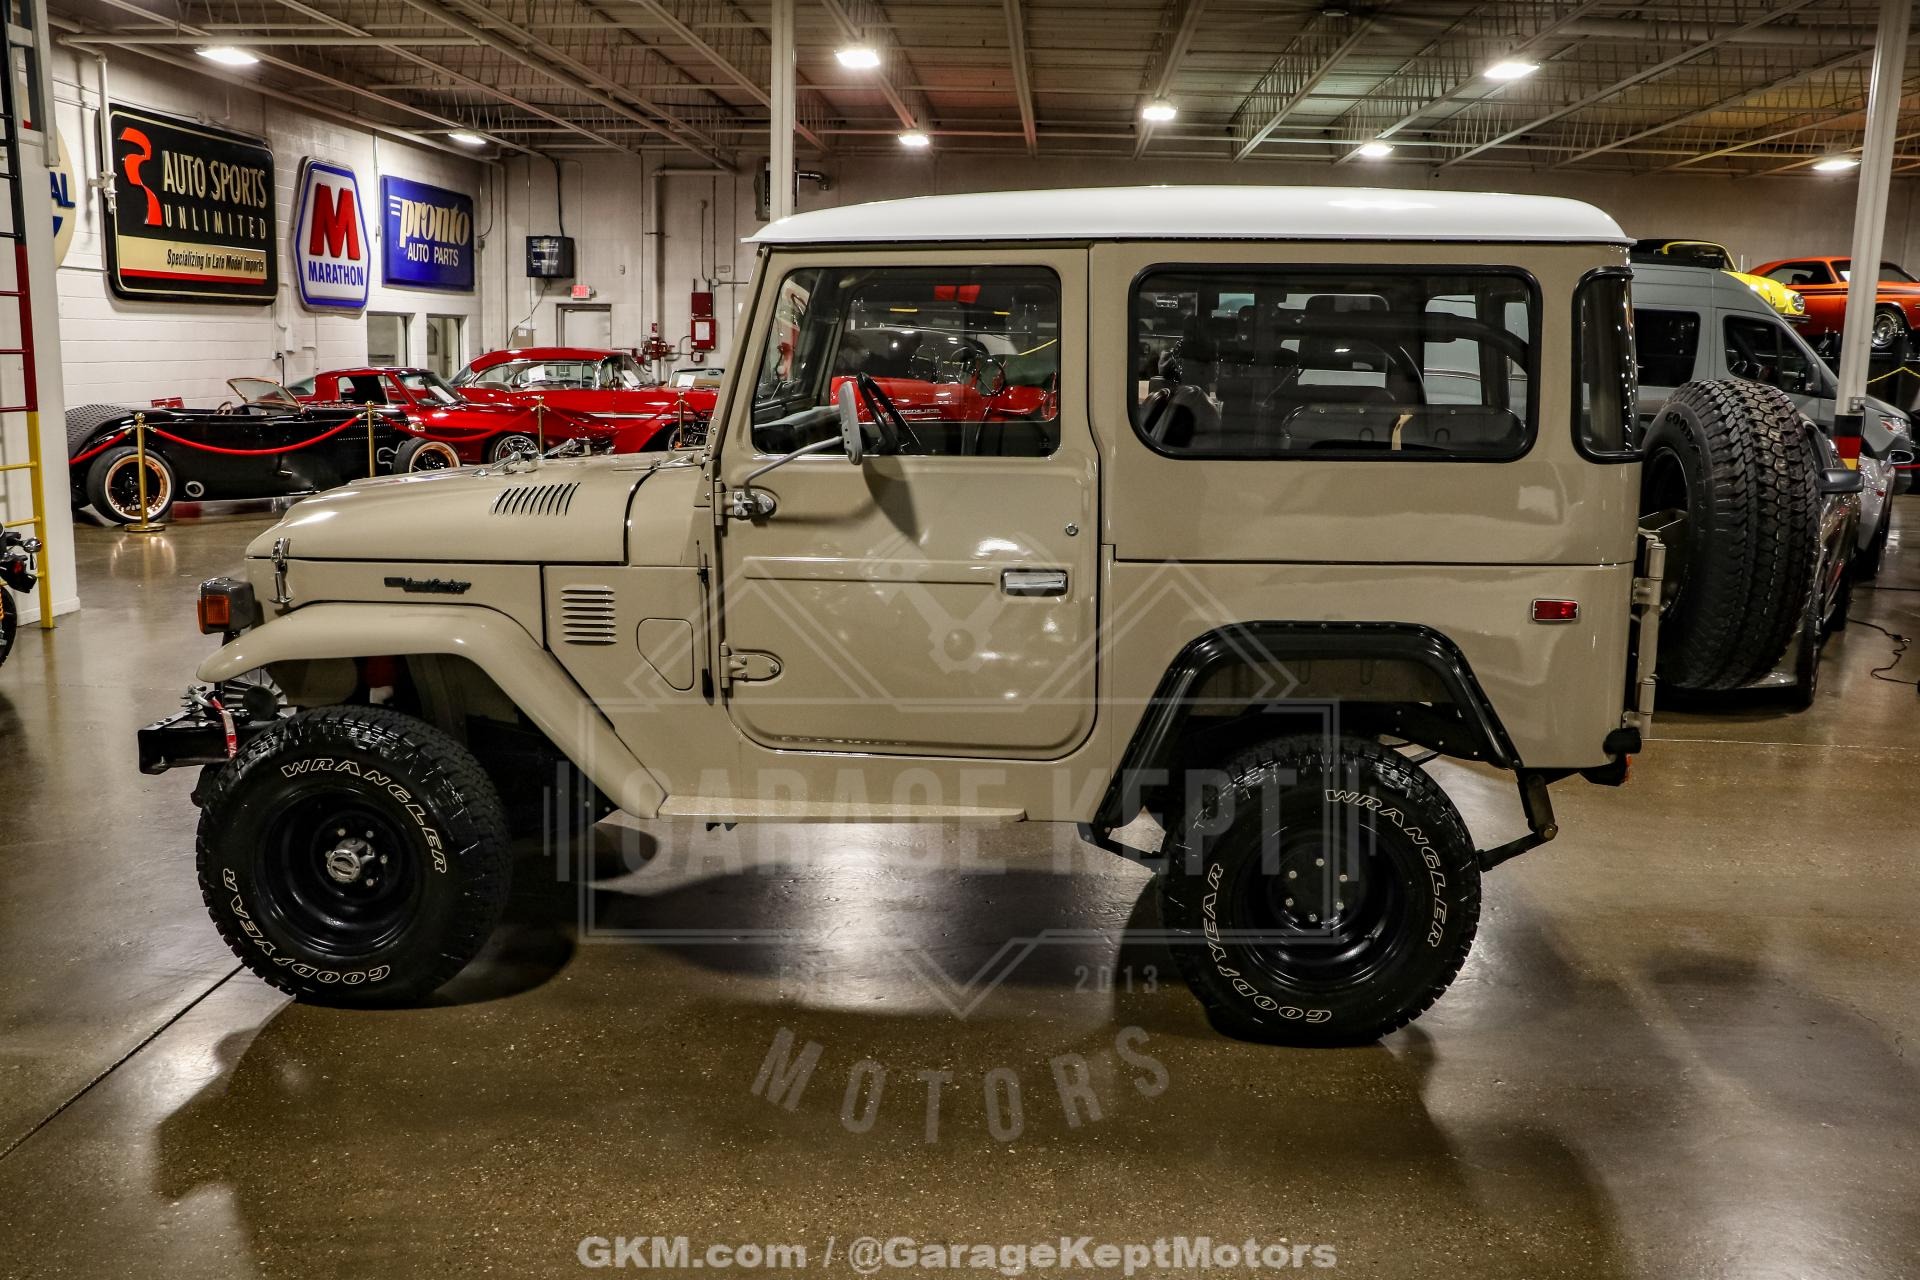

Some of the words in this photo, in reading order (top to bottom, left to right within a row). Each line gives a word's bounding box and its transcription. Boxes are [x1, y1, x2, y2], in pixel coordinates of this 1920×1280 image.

[162, 150, 206, 198] AUTO
[210, 160, 267, 208] SPORTS
[164, 204, 267, 239] UNLIMITED
[309, 183, 361, 260] M
[399, 197, 470, 247] pronto
[167, 249, 205, 270] Specializing
[308, 260, 364, 286] MARATHON
[407, 242, 429, 263] AUTO
[433, 247, 459, 267] PARTS
[281, 758, 447, 874] WRANGLER
[1325, 789, 1447, 947] WRANGLER
[222, 868, 391, 985] GOODYEAR
[1202, 863, 1332, 1023] GOODYEAR
